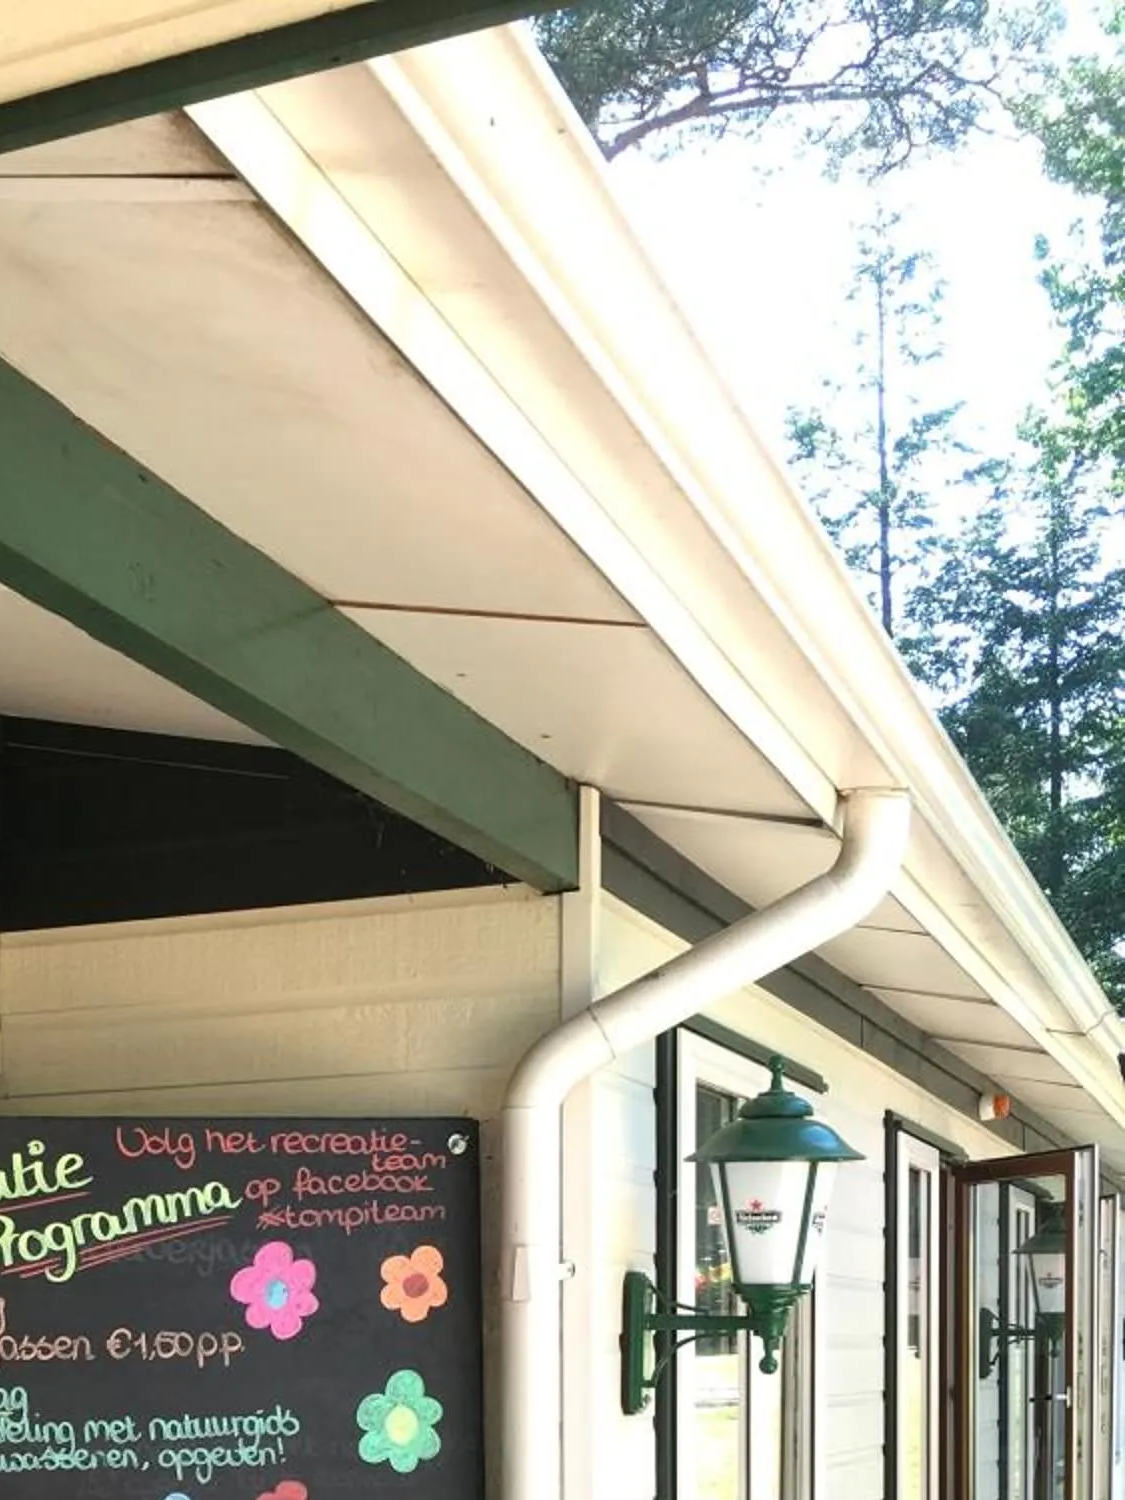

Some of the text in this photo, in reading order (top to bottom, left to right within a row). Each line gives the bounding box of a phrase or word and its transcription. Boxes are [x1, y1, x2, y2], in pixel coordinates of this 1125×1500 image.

[205, 1129, 267, 1155] het
[372, 1151, 446, 1172] team
[245, 1167, 433, 1206] op facebook
[84, 1414, 141, 1443] met
